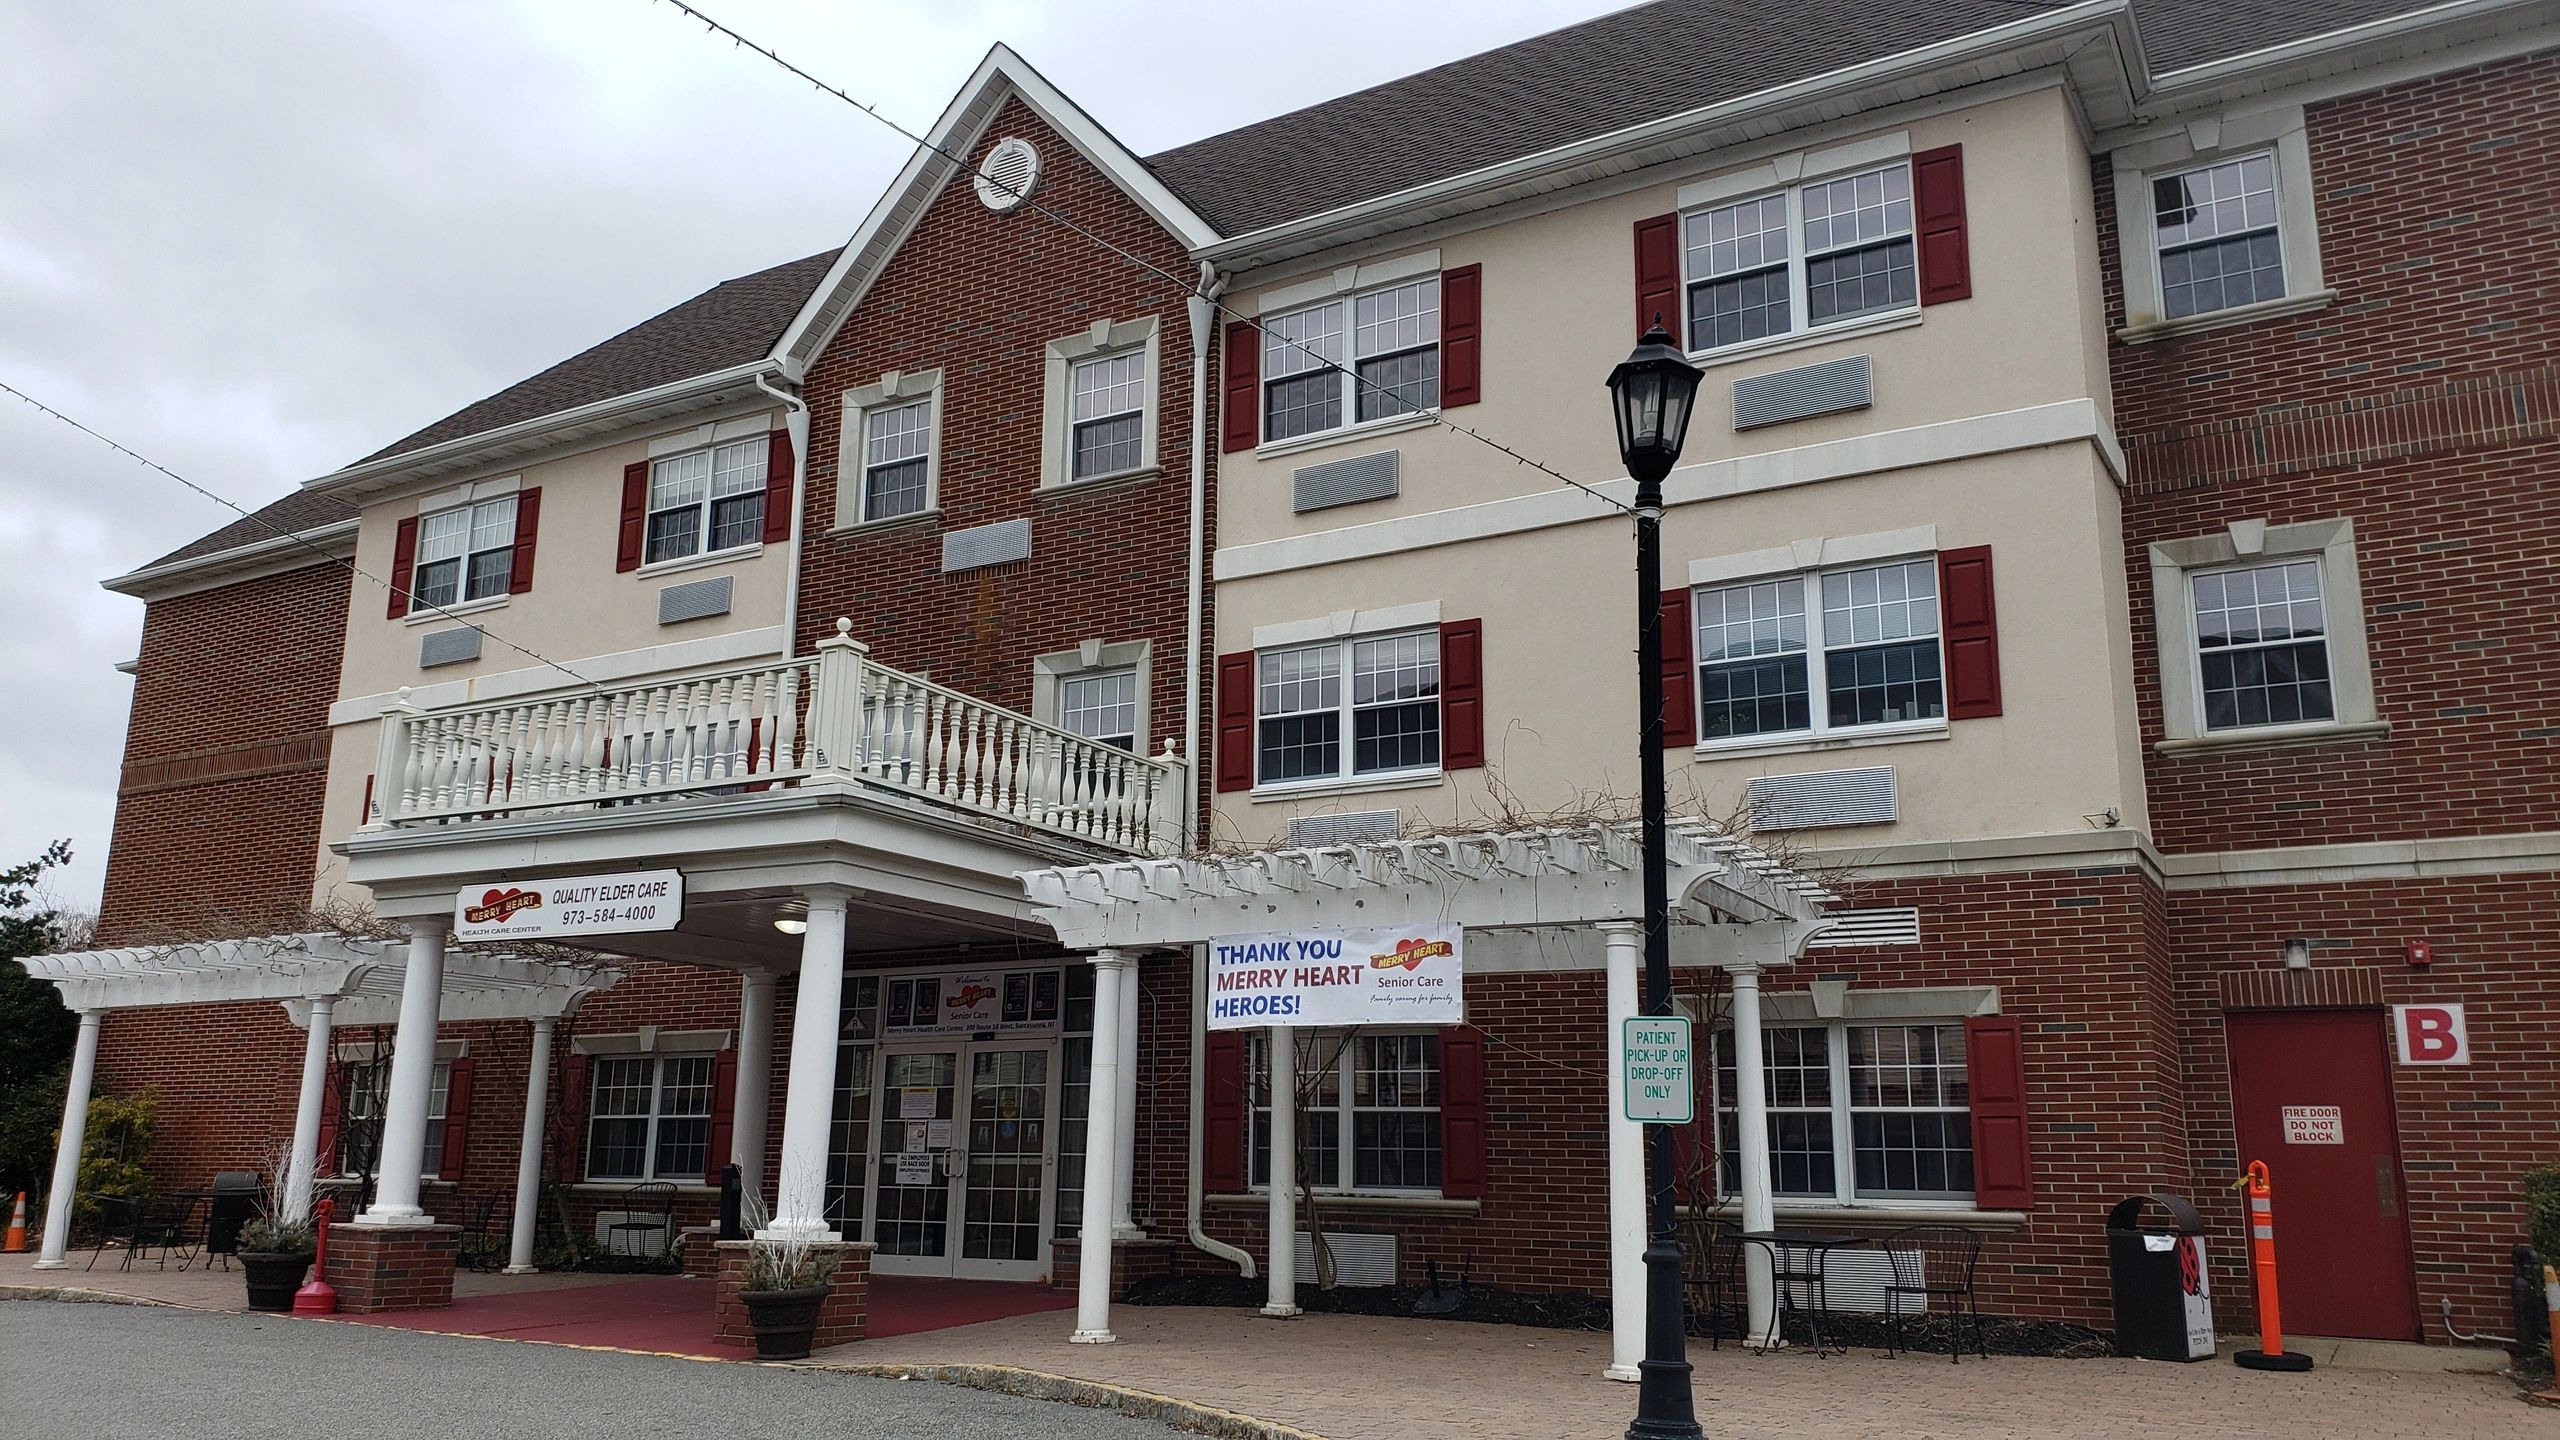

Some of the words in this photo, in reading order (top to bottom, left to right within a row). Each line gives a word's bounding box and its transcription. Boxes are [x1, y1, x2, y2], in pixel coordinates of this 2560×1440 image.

[552, 887, 598, 905] QUALITY
[600, 883, 635, 901] ELDER
[637, 881, 668, 898] CARE
[471, 906, 501, 921] MERRY
[505, 895, 535, 911] HEART
[562, 906, 656, 925] 973-584-4000
[491, 927, 511, 935] CARE
[511, 925, 542, 933] CENTER
[1217, 941, 1291, 966] THANK
[1296, 939, 1342, 960] YOU
[1378, 951, 1411, 969] MERRY
[1413, 943, 1444, 959] HEART
[1216, 968, 1288, 992] MERRY
[1293, 964, 1365, 988] HEART
[1378, 976, 1414, 988] Senior
[1417, 976, 1444, 987] Care
[1369, 993, 1393, 1006] Family
[1394, 996, 1417, 1004] caring
[1417, 993, 1428, 1005] for
[1428, 992, 1454, 1006] family
[1214, 995, 1301, 1018] HEROES!
[950, 1011, 972, 1020] Senior
[973, 1010, 989, 1019] Care
[1636, 1031, 1677, 1045] PATIENT
[2404, 1008, 2458, 1062] B
[1628, 1049, 1668, 1062] PICK-UP
[1672, 1049, 1687, 1062] OR
[1631, 1067, 1684, 1081] DROP-OFF
[1644, 1085, 1671, 1099] ONLY
[2284, 1108, 2307, 1118] FIRE
[2309, 1108, 2339, 1118] DOOR
[2290, 1120, 2307, 1130] DO
[2311, 1120, 2335, 1130] NOT
[2294, 1132, 2334, 1142] BLOCK
